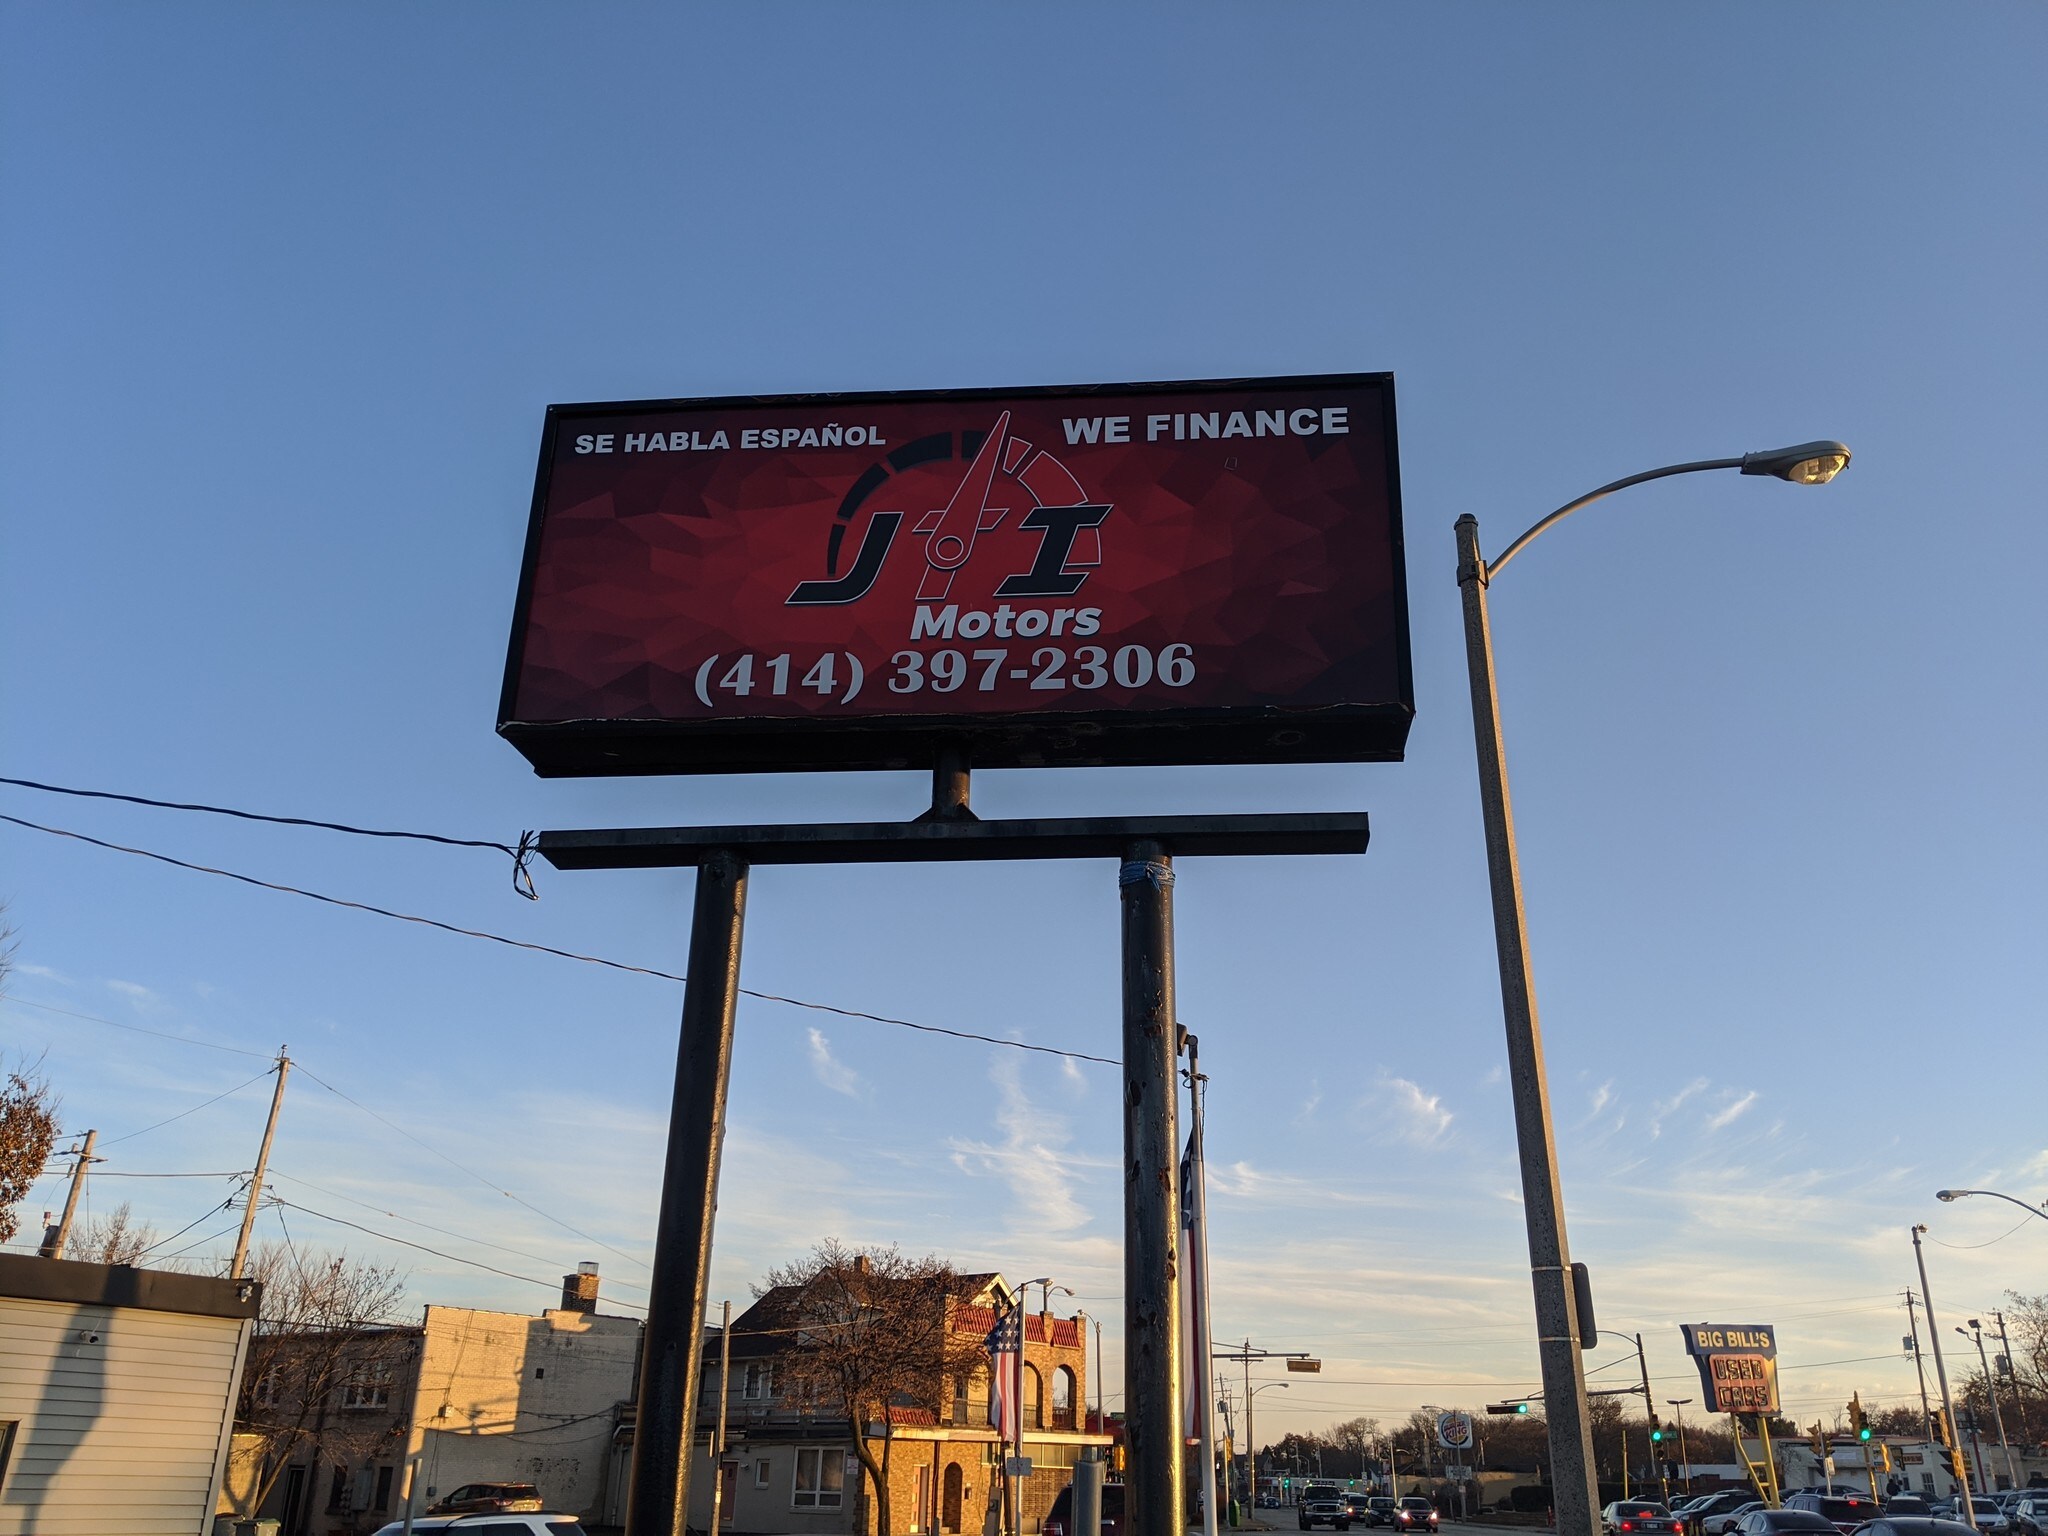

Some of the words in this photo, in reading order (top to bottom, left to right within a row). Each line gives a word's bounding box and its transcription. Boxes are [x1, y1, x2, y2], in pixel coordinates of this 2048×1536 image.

[574, 434, 615, 454] SE
[624, 430, 730, 452] HABLA
[740, 422, 886, 449] ESPAÑOL
[1062, 415, 1131, 445] WE
[1147, 407, 1350, 441] FINANCE
[910, 604, 1103, 640] Motors
[694, 651, 865, 708] (414)
[887, 643, 1197, 694] 397-2306
[1697, 1331, 1724, 1348] BIG
[1726, 1331, 1770, 1348] BILL'S
[1715, 1359, 1763, 1380] USED
[1719, 1386, 1769, 1408] CARS
